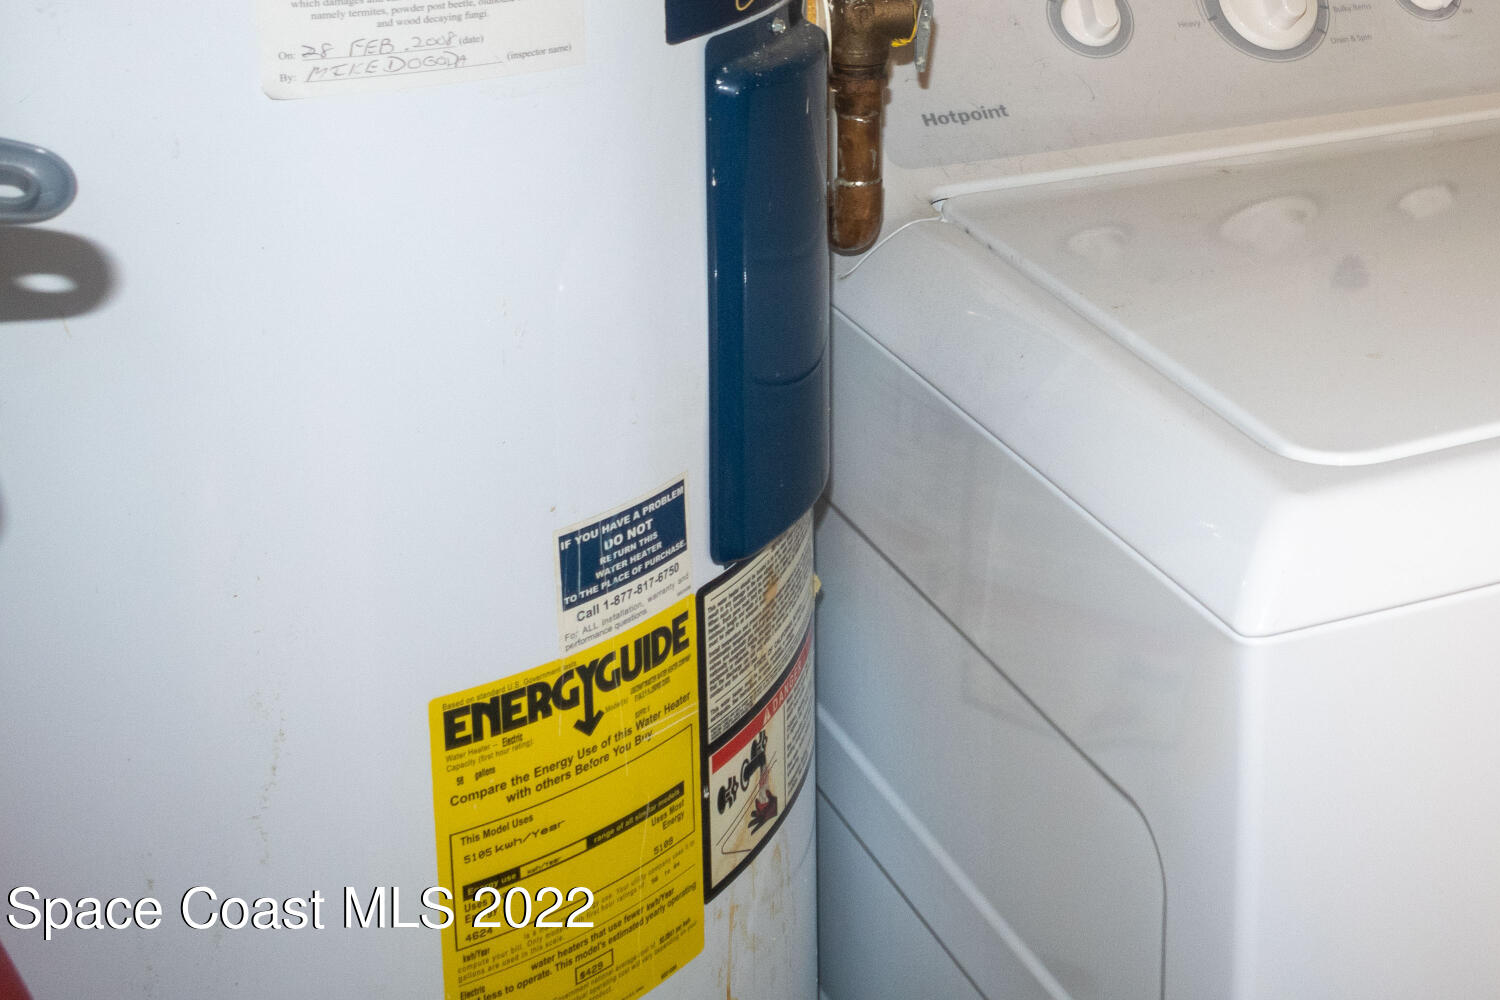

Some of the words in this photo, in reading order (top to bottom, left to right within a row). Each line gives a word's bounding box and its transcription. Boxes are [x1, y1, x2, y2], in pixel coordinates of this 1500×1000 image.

[291, 0, 320, 9] which
[311, 9, 346, 21] namely
[348, 6, 389, 18] termites,
[391, 2, 425, 16] powder
[427, 0, 446, 12] post
[376, 17, 394, 28] and
[395, 15, 421, 26] wood
[423, 12, 462, 24] decaying
[278, 50, 297, 60] On:
[302, 42, 334, 58] 28
[459, 34, 484, 46] (date)
[279, 73, 297, 85] By:
[305, 59, 379, 83] MIKE
[507, 50, 546, 61] (inspector
[548, 43, 572, 56] name)
[921, 104, 1009, 127] Hotpoint
[560, 540, 573, 551] IF
[575, 528, 599, 545] YOU
[601, 515, 631, 535] HAVE
[632, 510, 641, 521] A
[641, 485, 684, 516] PROBLEM
[603, 533, 624, 551] DO
[627, 518, 655, 541] NOT
[595, 559, 628, 580] WATER
[629, 541, 663, 566] HEATER
[599, 543, 638, 566] RETURN
[638, 530, 659, 548] THIS
[564, 594, 578, 606] TO
[580, 584, 599, 599] THE
[600, 572, 631, 590] PLACE
[632, 565, 643, 576] OF
[576, 603, 600, 622] Call
[582, 622, 598, 635] ALL
[565, 625, 613, 652] performance
[443, 610, 690, 752] ENERGYGUIDE
[450, 781, 507, 807] Compare
[510, 773, 530, 787] the
[533, 754, 574, 779] Energy
[576, 744, 598, 760] Use
[601, 735, 612, 749] of
[614, 726, 633, 743] this
[635, 710, 662, 731] Water
[663, 691, 691, 715] Heater
[506, 785, 532, 804] with
[535, 770, 572, 793] others
[575, 753, 609, 776] Before
[612, 743, 632, 758] You
[460, 834, 480, 847] This
[482, 823, 510, 840] Model
[511, 814, 534, 829] Uses
[651, 812, 668, 827] Uses
[662, 811, 685, 831] Energy
[463, 847, 493, 865] 5105
[494, 819, 566, 853] kwh/Year
[504, 985, 515, 995] to
[517, 969, 553, 989] operate.
[554, 958, 573, 972] This
[574, 940, 606, 962] model's
[607, 916, 644, 944] estimated
[645, 903, 666, 926] yearly
[666, 880, 697, 908] operating
[531, 954, 555, 971] water
[557, 937, 589, 959] heaters
[590, 928, 606, 942] that
[607, 919, 622, 932] use
[623, 907, 644, 925] fewer
